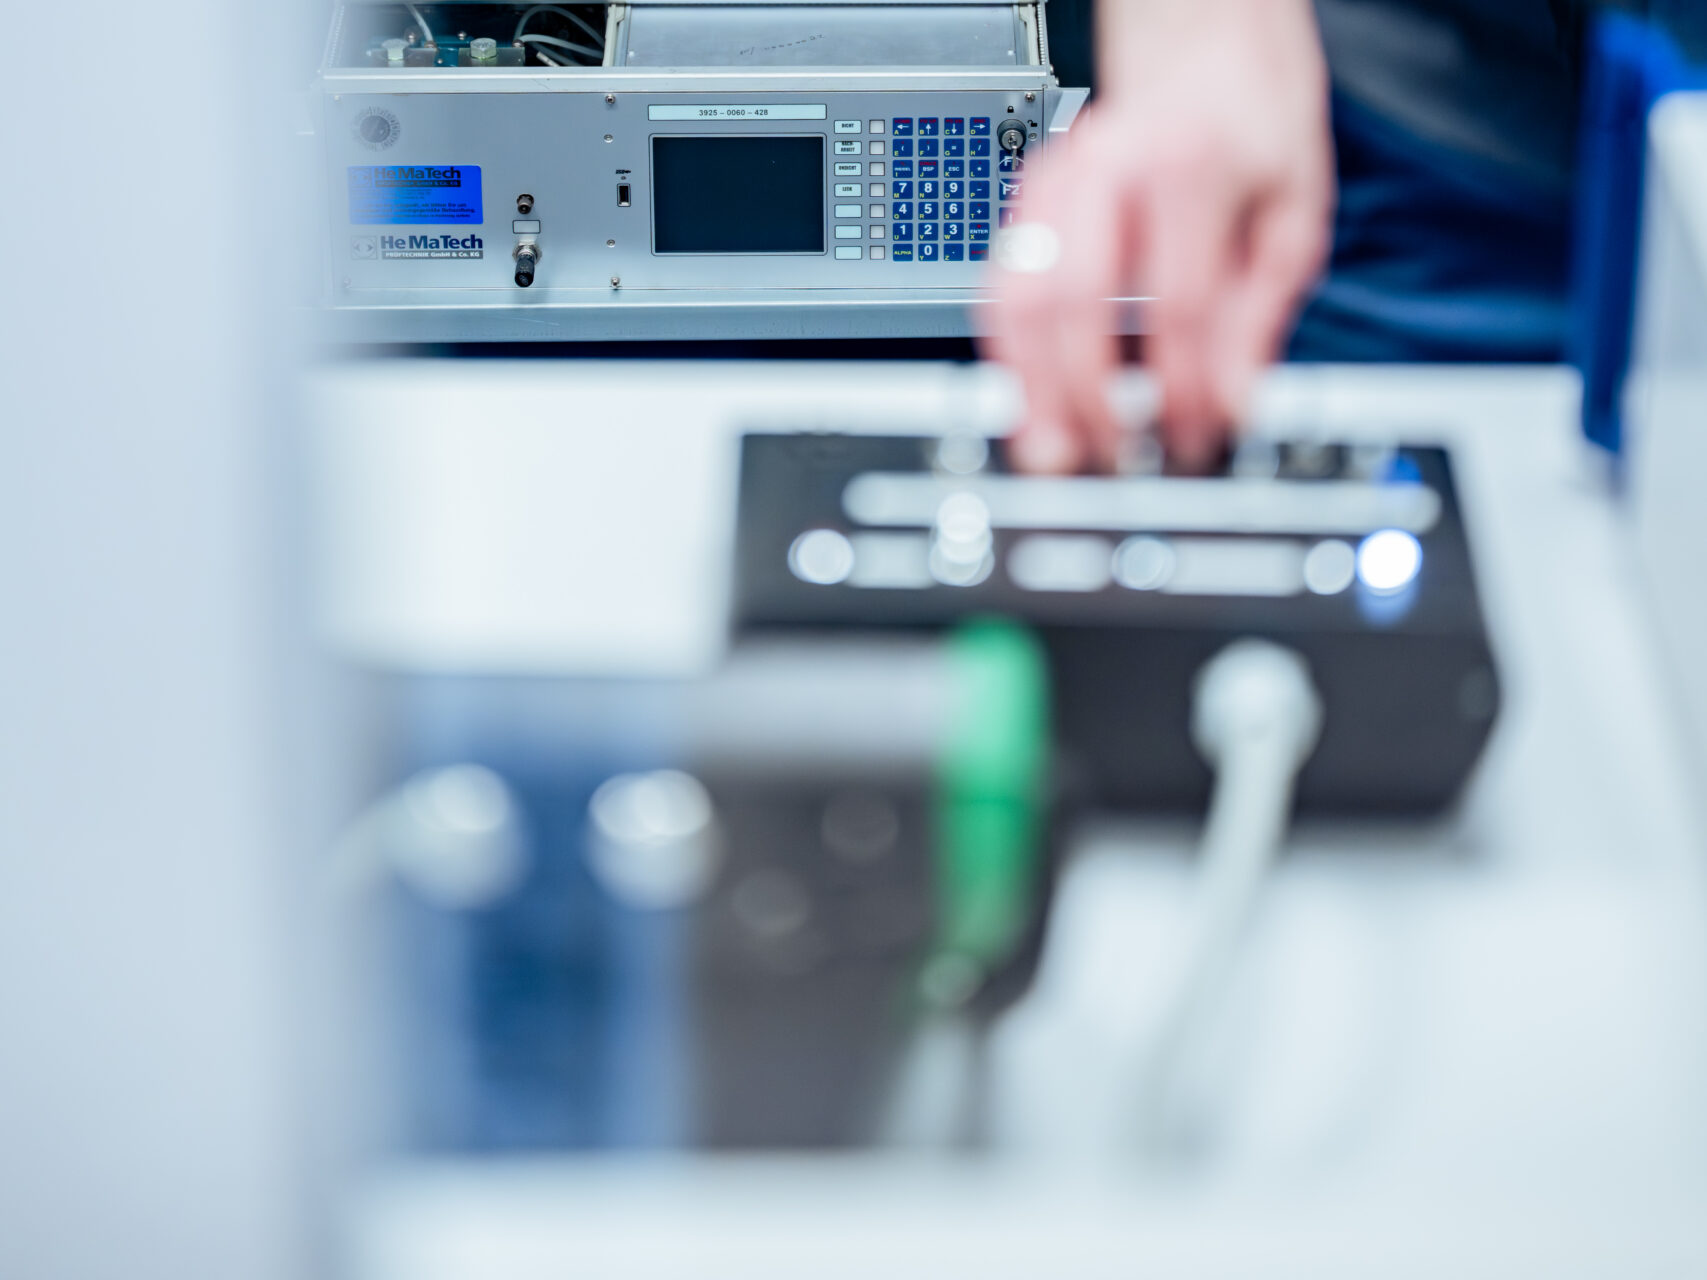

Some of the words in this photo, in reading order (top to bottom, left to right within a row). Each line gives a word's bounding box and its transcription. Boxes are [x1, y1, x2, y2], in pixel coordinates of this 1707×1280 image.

[899, 183, 907, 193] 7
[924, 183, 932, 193] 8
[950, 182, 958, 192] 9
[899, 204, 907, 214] 4
[924, 204, 932, 214] 5
[949, 204, 958, 214] 6
[900, 225, 905, 235] 1
[924, 224, 932, 235] 2
[950, 224, 958, 234] 3
[924, 245, 932, 255] 0
